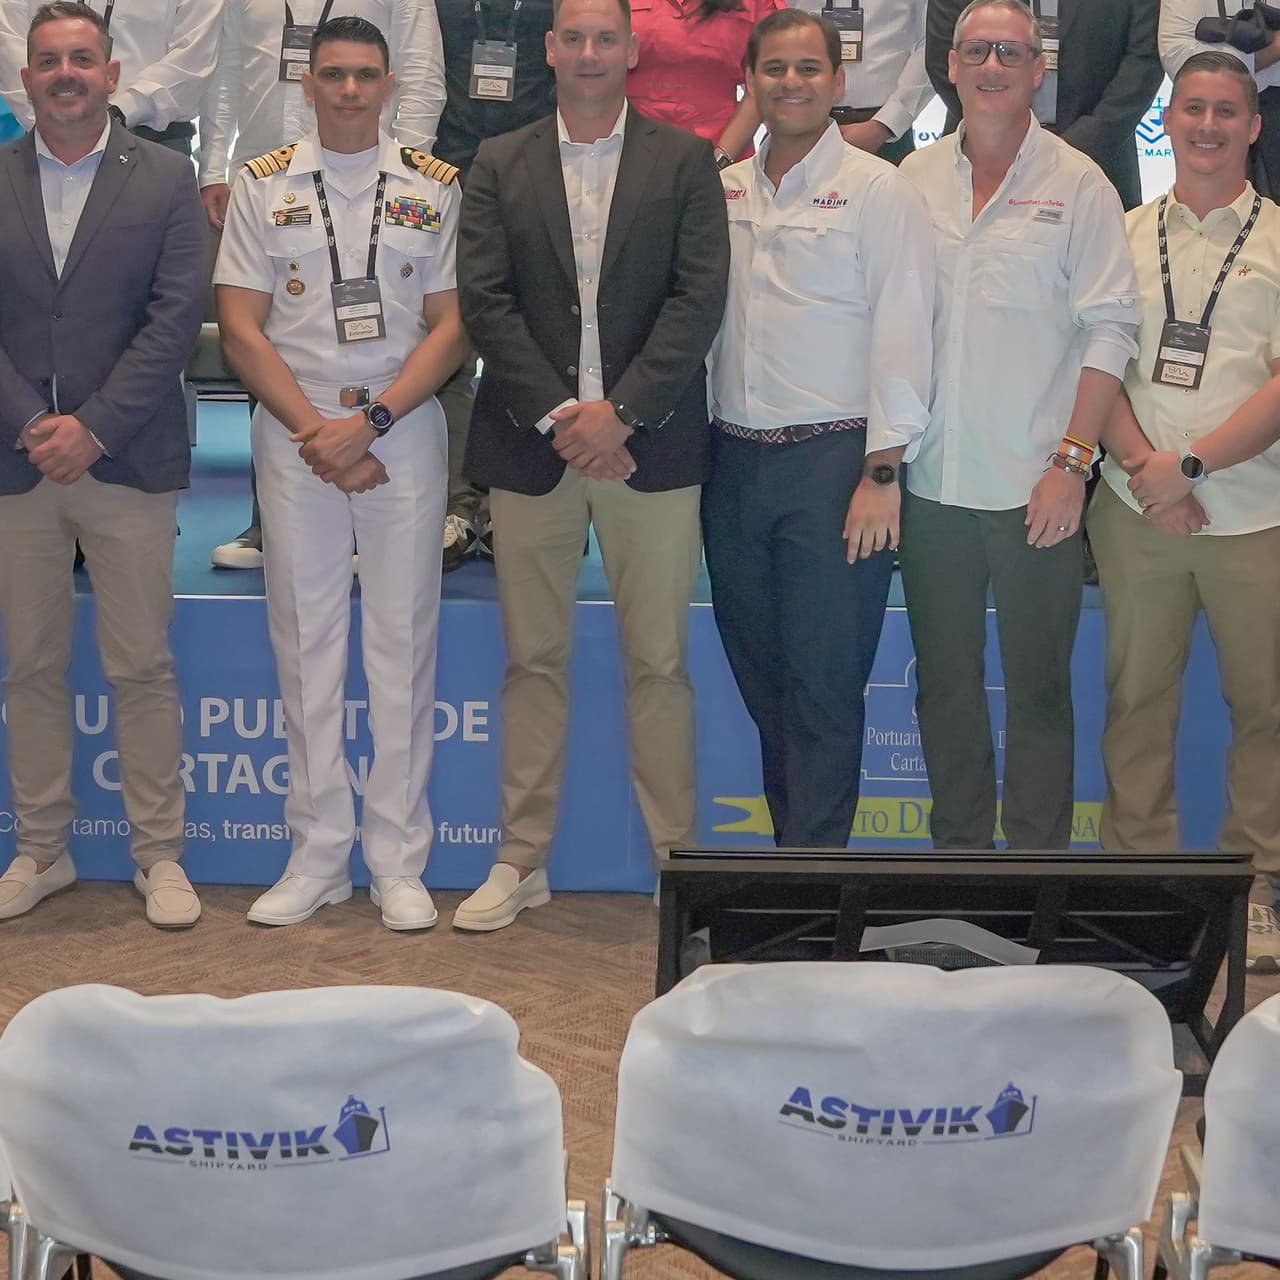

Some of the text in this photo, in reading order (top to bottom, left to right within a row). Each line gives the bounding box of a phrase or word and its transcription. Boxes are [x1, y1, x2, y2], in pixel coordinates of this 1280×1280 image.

[200, 697, 370, 740] PUET
[867, 727, 921, 746] Portuari
[92, 750, 368, 795] CRTAGN
[891, 752, 926, 771] Carta
[779, 1086, 983, 1136] ASTIVIK
[128, 1124, 331, 1160] ASTIVIK
[838, 1133, 917, 1147] SHIPYARD
[189, 1159, 268, 1171] SHIPYARD
